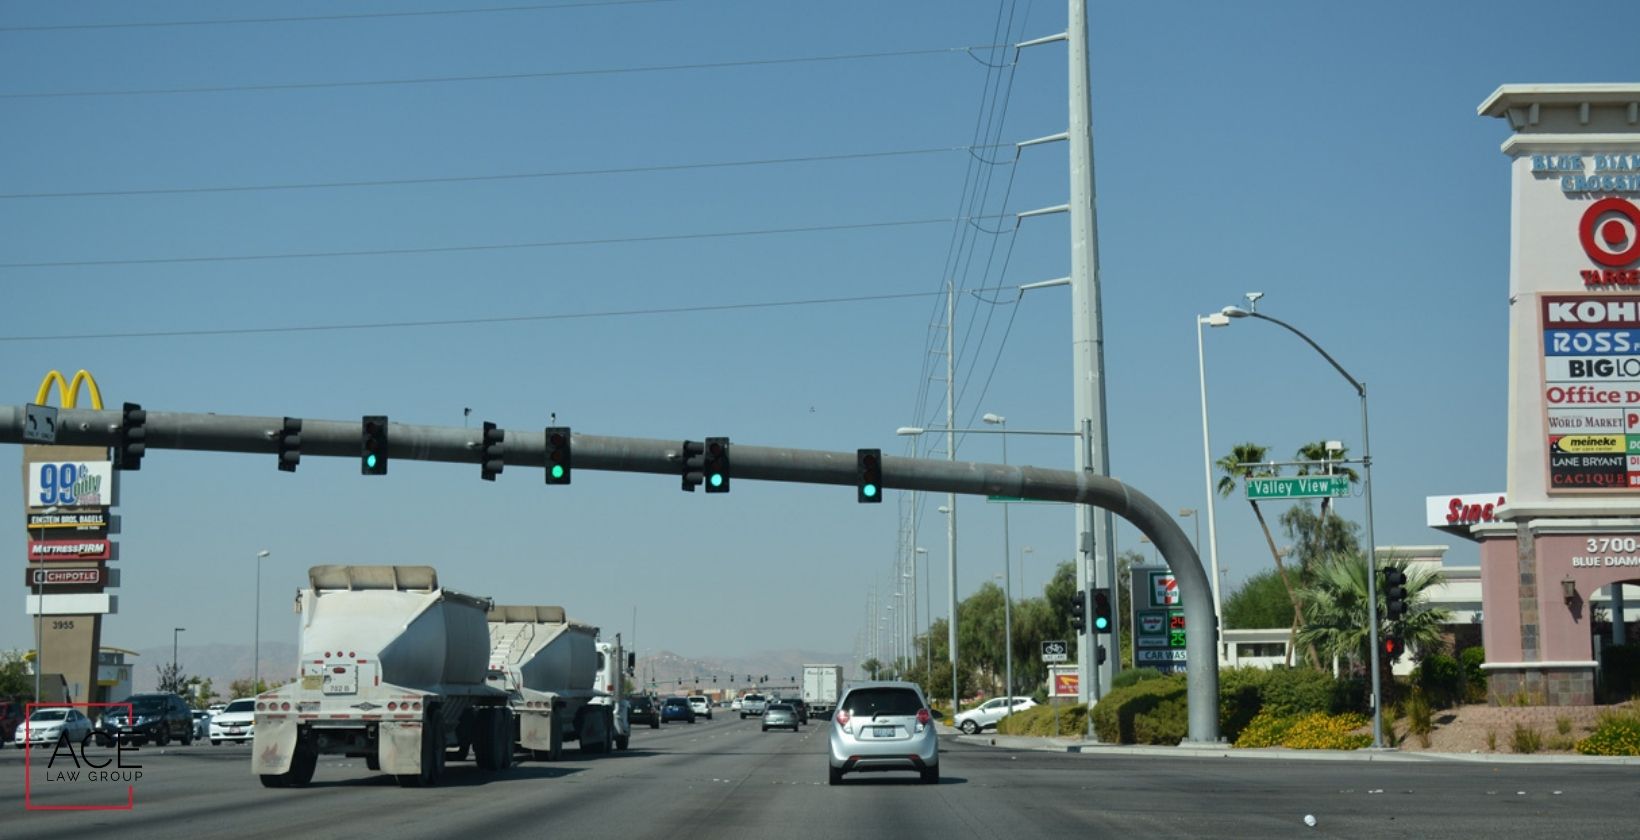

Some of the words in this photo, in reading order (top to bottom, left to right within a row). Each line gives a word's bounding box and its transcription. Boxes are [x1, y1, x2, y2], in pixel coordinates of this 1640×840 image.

[1532, 154, 1582, 171] BLUE
[1549, 301, 1640, 323] KOH
[1554, 332, 1630, 352] ROSS
[1547, 386, 1621, 404] Office
[1548, 417, 1583, 428] WORLD
[1585, 416, 1624, 428] MARKET
[1570, 437, 1617, 446] meineke
[1552, 457, 1579, 467] LANE
[1583, 457, 1624, 466] BRYANT
[1553, 473, 1625, 484] CACIQUE
[1255, 480, 1292, 496] Valley
[1300, 479, 1328, 493] View
[31, 515, 60, 524] EINSTEIN
[79, 514, 104, 523] BAGELS
[1572, 556, 1601, 567] BLUE
[1604, 556, 1640, 567] DIAM
[48, 572, 97, 580] CHIPOTLE
[52, 621, 75, 630] 3955
[1145, 652, 1163, 660] CAR
